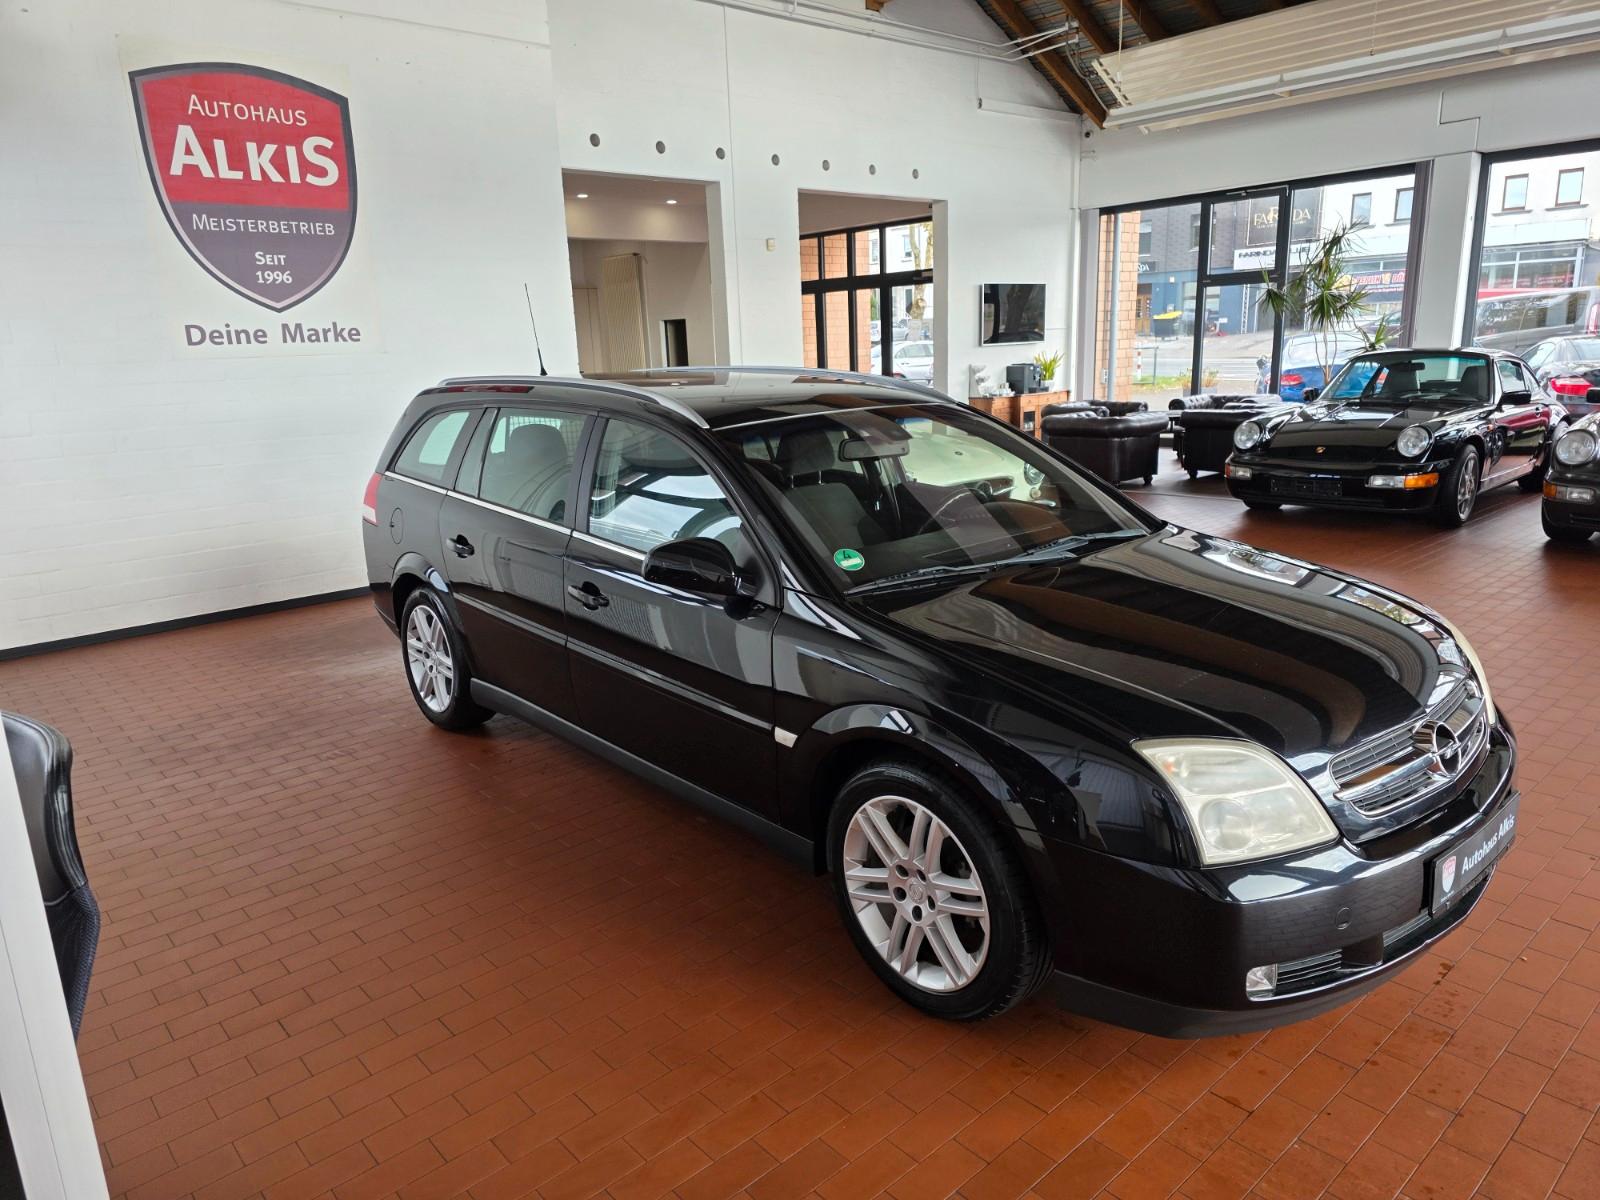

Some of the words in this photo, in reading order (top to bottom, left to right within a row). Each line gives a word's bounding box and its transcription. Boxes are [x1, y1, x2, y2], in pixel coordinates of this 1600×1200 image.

[187, 93, 308, 127] AUTOHAUS
[192, 213, 335, 236] MEISTERBETRIEB
[255, 251, 287, 266] SEIT
[255, 270, 293, 284] 1996
[184, 322, 268, 347] Deine
[281, 321, 361, 344] Marke
[1461, 832, 1498, 874] Autohaus
[1498, 814, 1515, 839] Alkis
